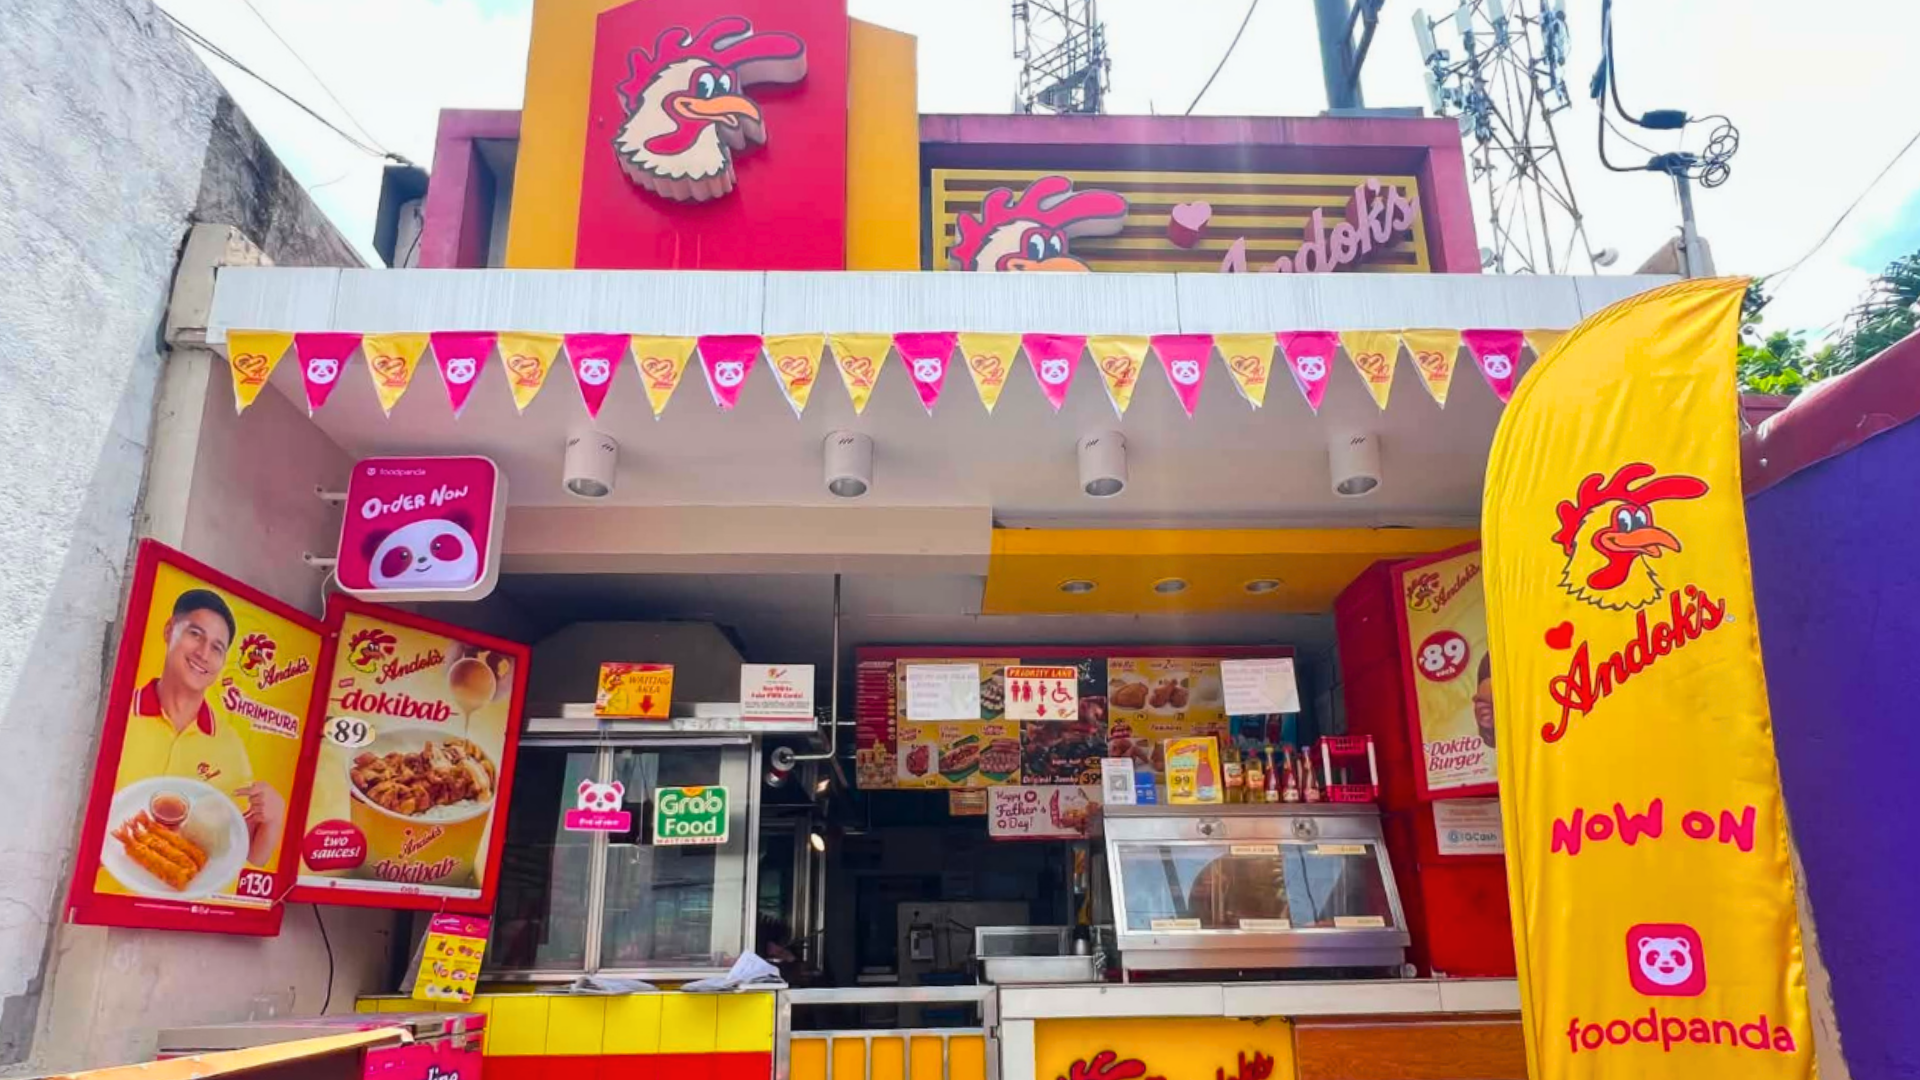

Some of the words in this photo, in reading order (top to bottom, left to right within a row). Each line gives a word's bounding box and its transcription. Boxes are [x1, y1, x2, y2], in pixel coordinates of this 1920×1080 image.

[380, 467, 426, 477] foodpanda
[257, 656, 310, 690] Andok's
[376, 649, 445, 684] Andok's
[1009, 668, 1048, 678] PRIORITY
[1541, 584, 1726, 743] Andok's
[629, 675, 670, 686] WAITING
[340, 689, 451, 722] dokibab
[1431, 736, 1482, 757] Dokito
[1429, 752, 1485, 772] Burger
[660, 789, 722, 815] Grab
[995, 802, 1047, 818] Father's
[665, 816, 717, 836] Food
[1009, 818, 1033, 832] Day!
[323, 835, 349, 847] two
[310, 846, 361, 860] sauces!
[373, 858, 454, 883] dokibab
[1567, 1006, 1796, 1054] foodpanda
